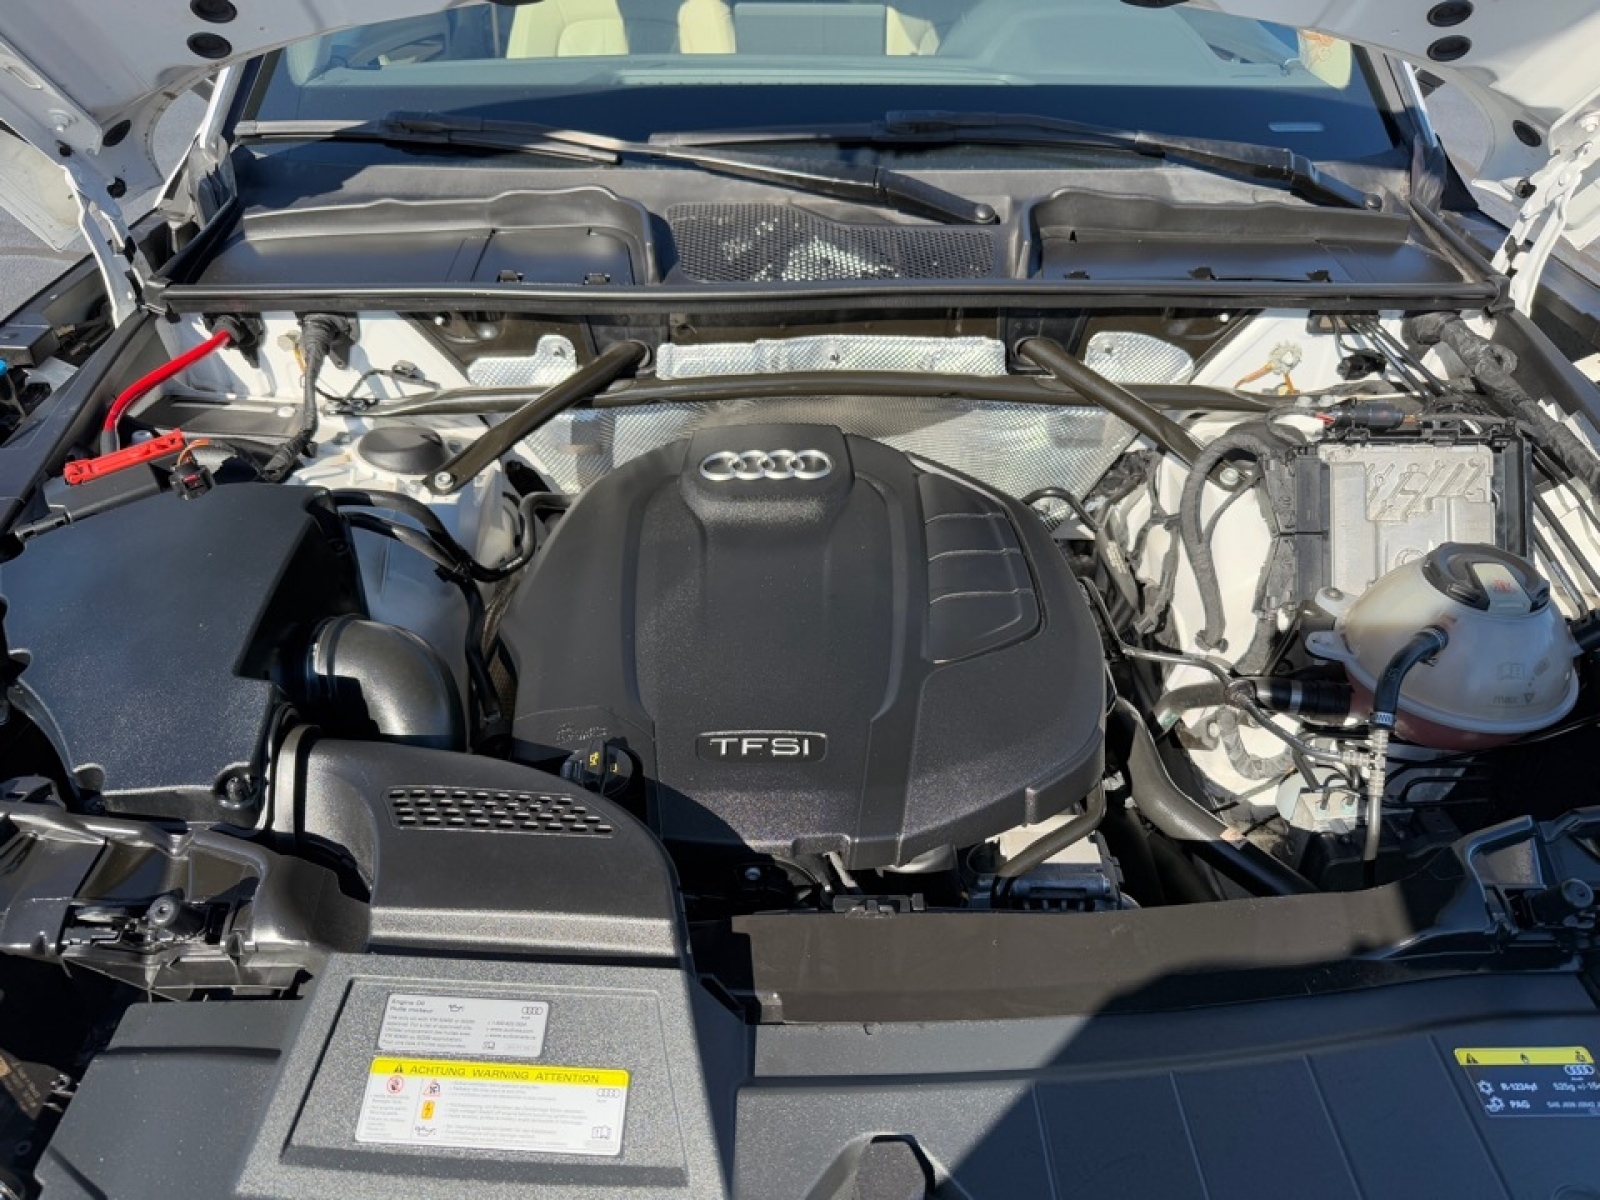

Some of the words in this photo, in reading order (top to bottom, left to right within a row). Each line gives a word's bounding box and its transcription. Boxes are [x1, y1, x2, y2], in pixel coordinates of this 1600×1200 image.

[710, 737, 810, 757] TFSI
[410, 1065, 466, 1076] ACHTUNG
[472, 1069, 529, 1081] WARNING
[535, 1072, 600, 1084] ATTENTION
[1509, 1100, 1530, 1109] PAG
